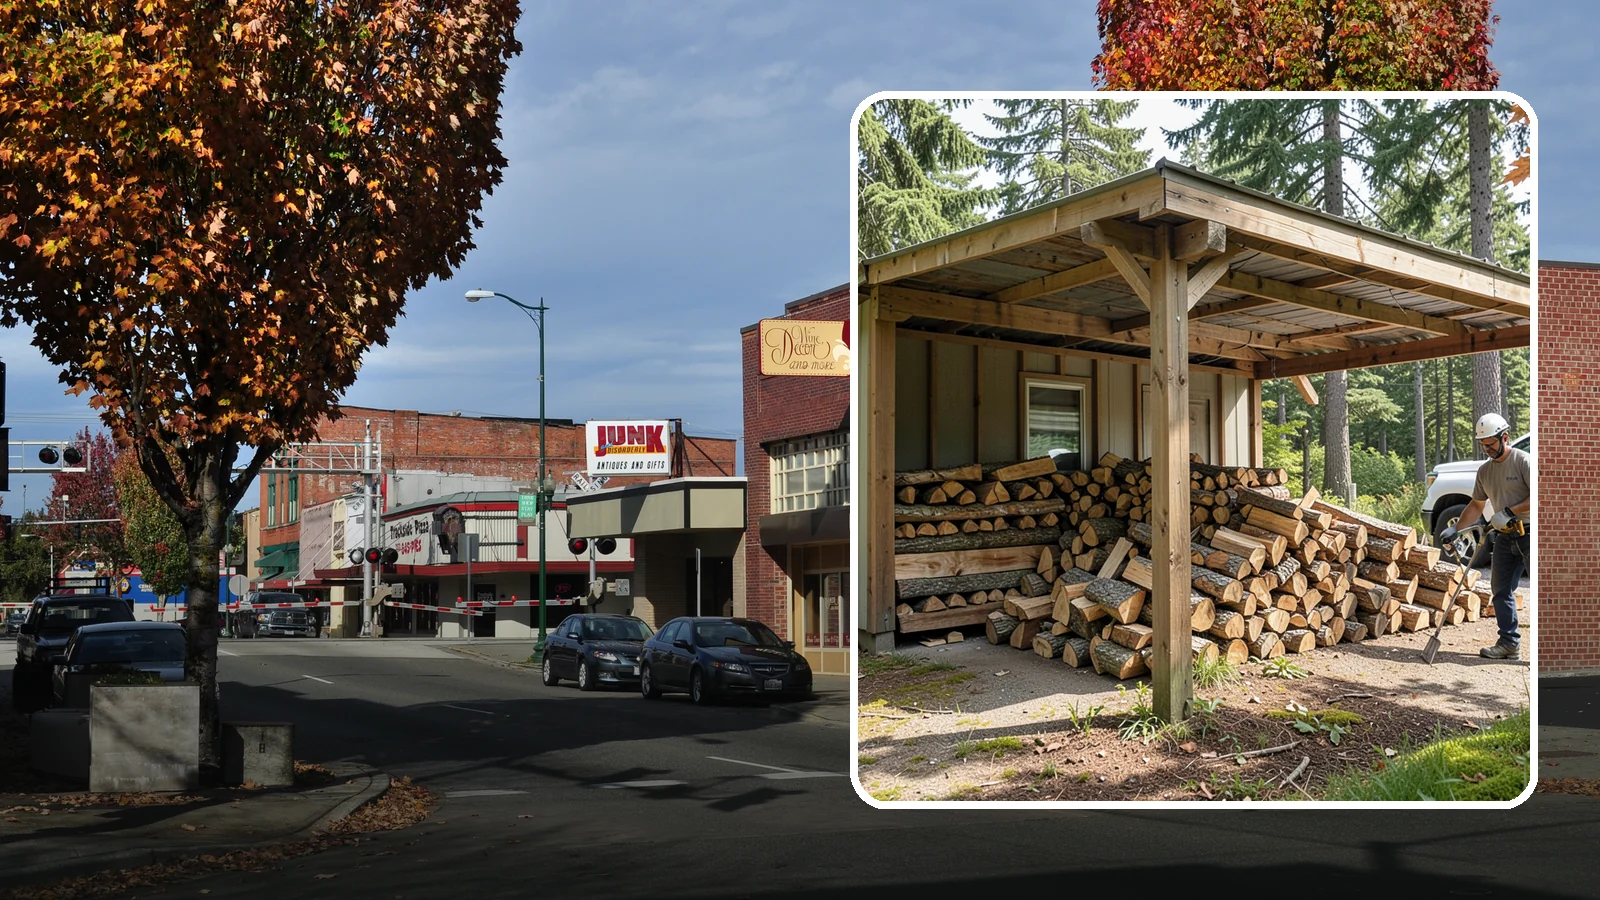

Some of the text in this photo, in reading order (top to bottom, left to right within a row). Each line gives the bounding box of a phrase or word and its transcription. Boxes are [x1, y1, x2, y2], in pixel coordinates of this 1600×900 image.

[595, 425, 665, 457] JUNK
[607, 446, 646, 454] DISORDERLY
[597, 460, 666, 470] ANTIQUES AND GIFTS
[390, 519, 429, 540] Trackside Pizza
